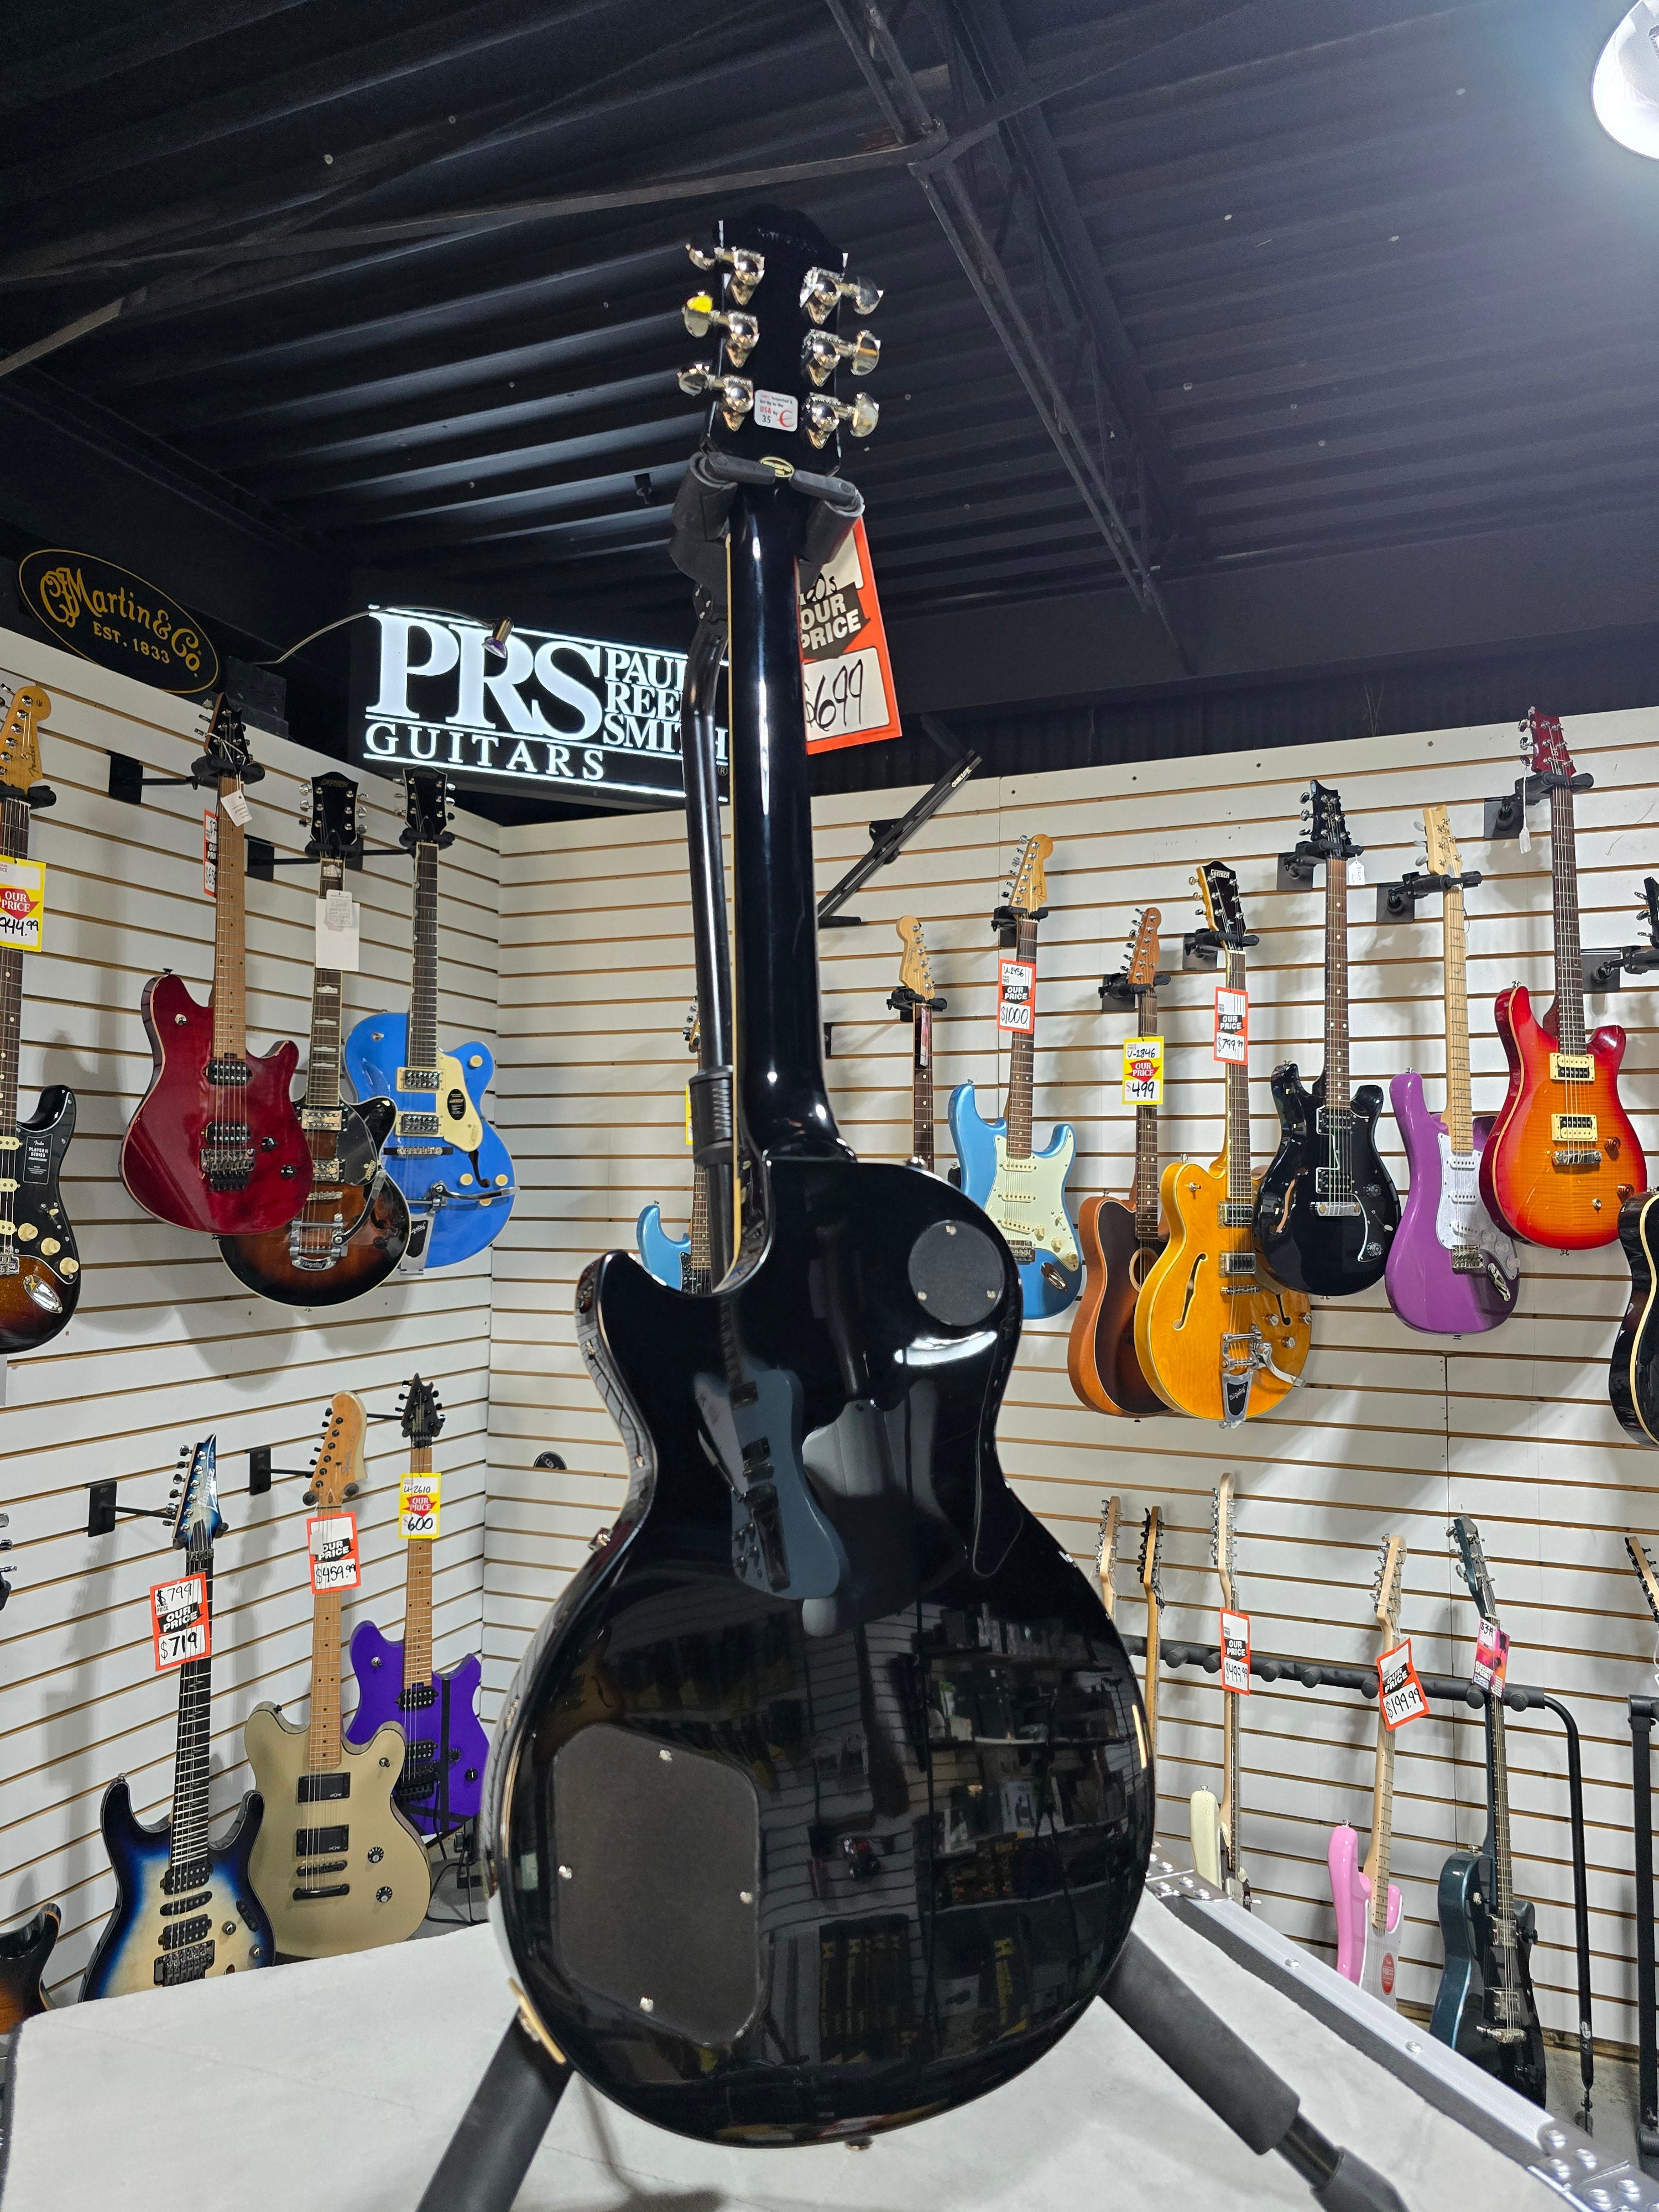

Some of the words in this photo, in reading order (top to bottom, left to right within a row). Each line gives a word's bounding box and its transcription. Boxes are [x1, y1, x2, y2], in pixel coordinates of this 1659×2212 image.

[762, 414, 771, 424] 35
[801, 593, 846, 630] OUR
[801, 609, 861, 650] PRICE
[93, 622, 128, 648] EST.
[133, 638, 170, 664] 1833
[366, 613, 603, 741] PRS
[604, 680, 684, 721] REE
[366, 723, 604, 780] GUITARS
[1210, 869, 1230, 879] GRETSCH
[2, 899, 30, 912] PRICE
[5, 891, 27, 902] OUR
[1001, 1006, 1028, 1024] $1000
[1126, 1081, 1155, 1099] $499
[341, 1449, 352, 1477] Squier
[197, 1468, 215, 1506] Ibanez
[403, 1516, 433, 1531] $600
[318, 1546, 349, 1561] PRICE
[322, 1540, 343, 1551] OUR
[156, 1583, 192, 1606] $799
[163, 1611, 198, 1633] PRICE
[166, 1606, 191, 1623] OUR
[160, 1631, 197, 1660] $719
[1227, 1647, 1246, 1656] PRICE
[1228, 1640, 1243, 1648] OUR
[1385, 1670, 1408, 1694] PRICE
[1386, 1667, 1402, 1684] OUR
[1385, 1688, 1423, 1719] $199.99
